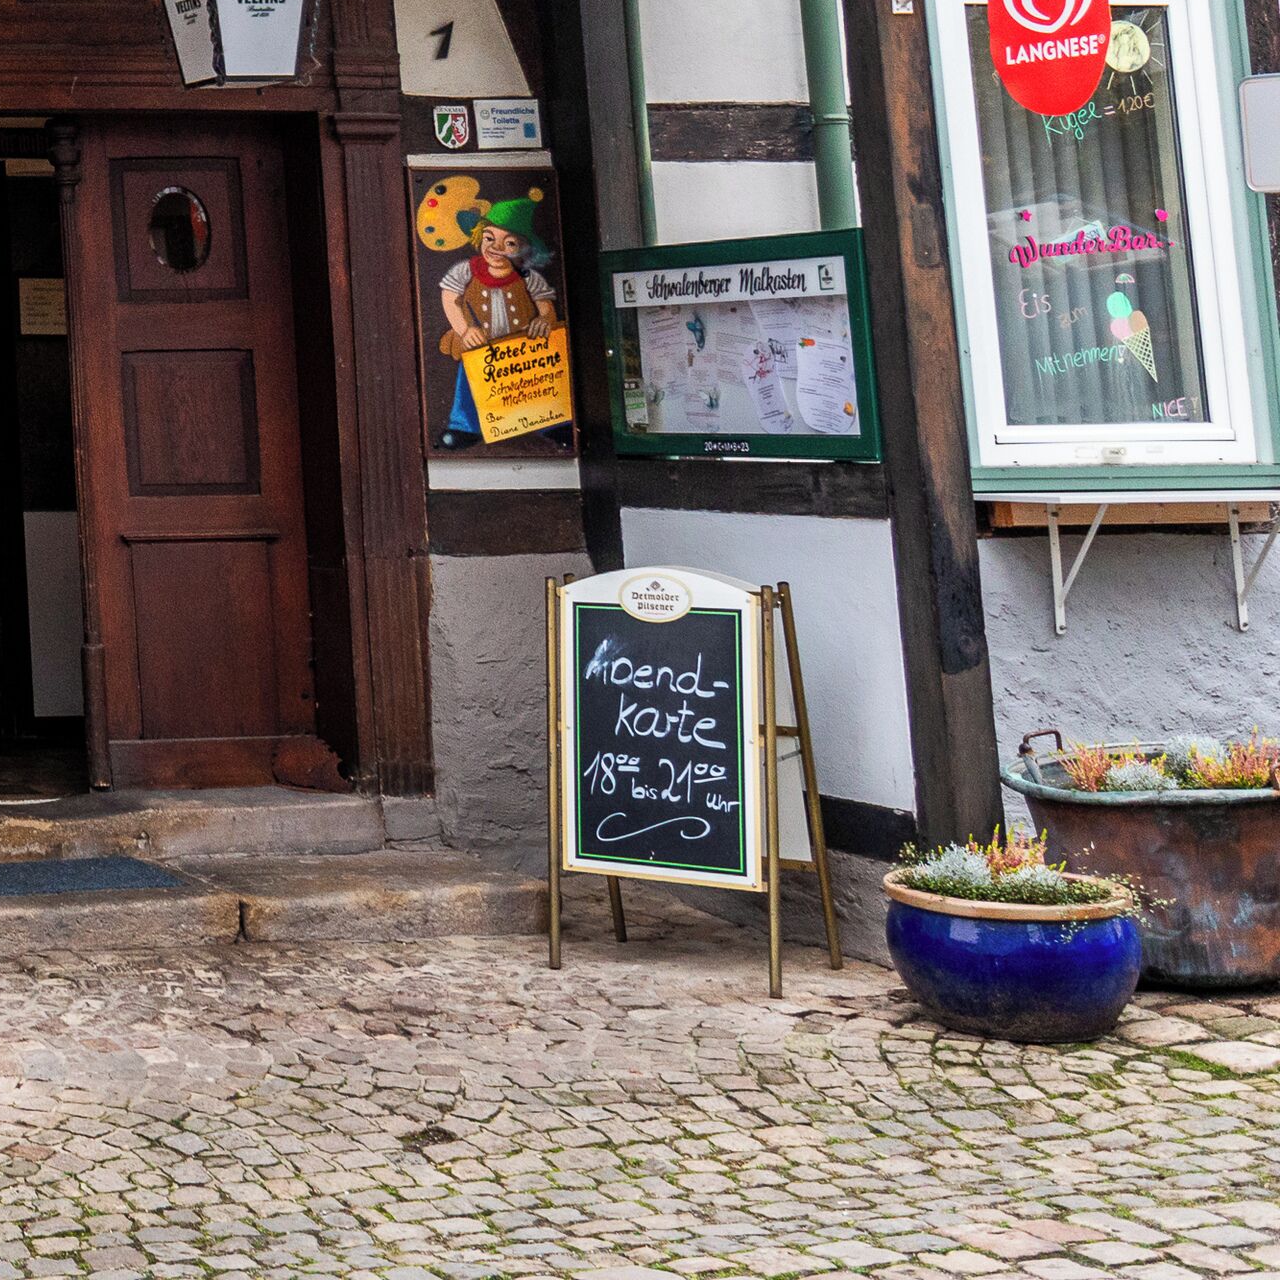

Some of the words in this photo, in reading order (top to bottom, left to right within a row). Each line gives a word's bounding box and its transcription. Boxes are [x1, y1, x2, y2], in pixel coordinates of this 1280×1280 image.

[429, 20, 454, 60] 1
[1006, 34, 1100, 65] LANGNESE
[491, 107, 535, 115] Freundliche
[492, 117, 520, 125] Toilette
[1041, 101, 1102, 150] Kugel
[1116, 93, 1156, 116] 1,20€
[646, 271, 732, 300] Schwalenberger
[739, 266, 807, 296] Malkasten
[1018, 288, 1052, 319] Eis
[484, 341, 526, 365] Hotel
[528, 337, 549, 353] und
[483, 352, 561, 383] Restaurant
[487, 370, 564, 401] Schwalenberger
[502, 386, 559, 407] Malkasten
[1152, 397, 1187, 419] NICE
[631, 591, 680, 602] Detmolder
[637, 602, 675, 611] Pilsener
[631, 777, 658, 800] bis
